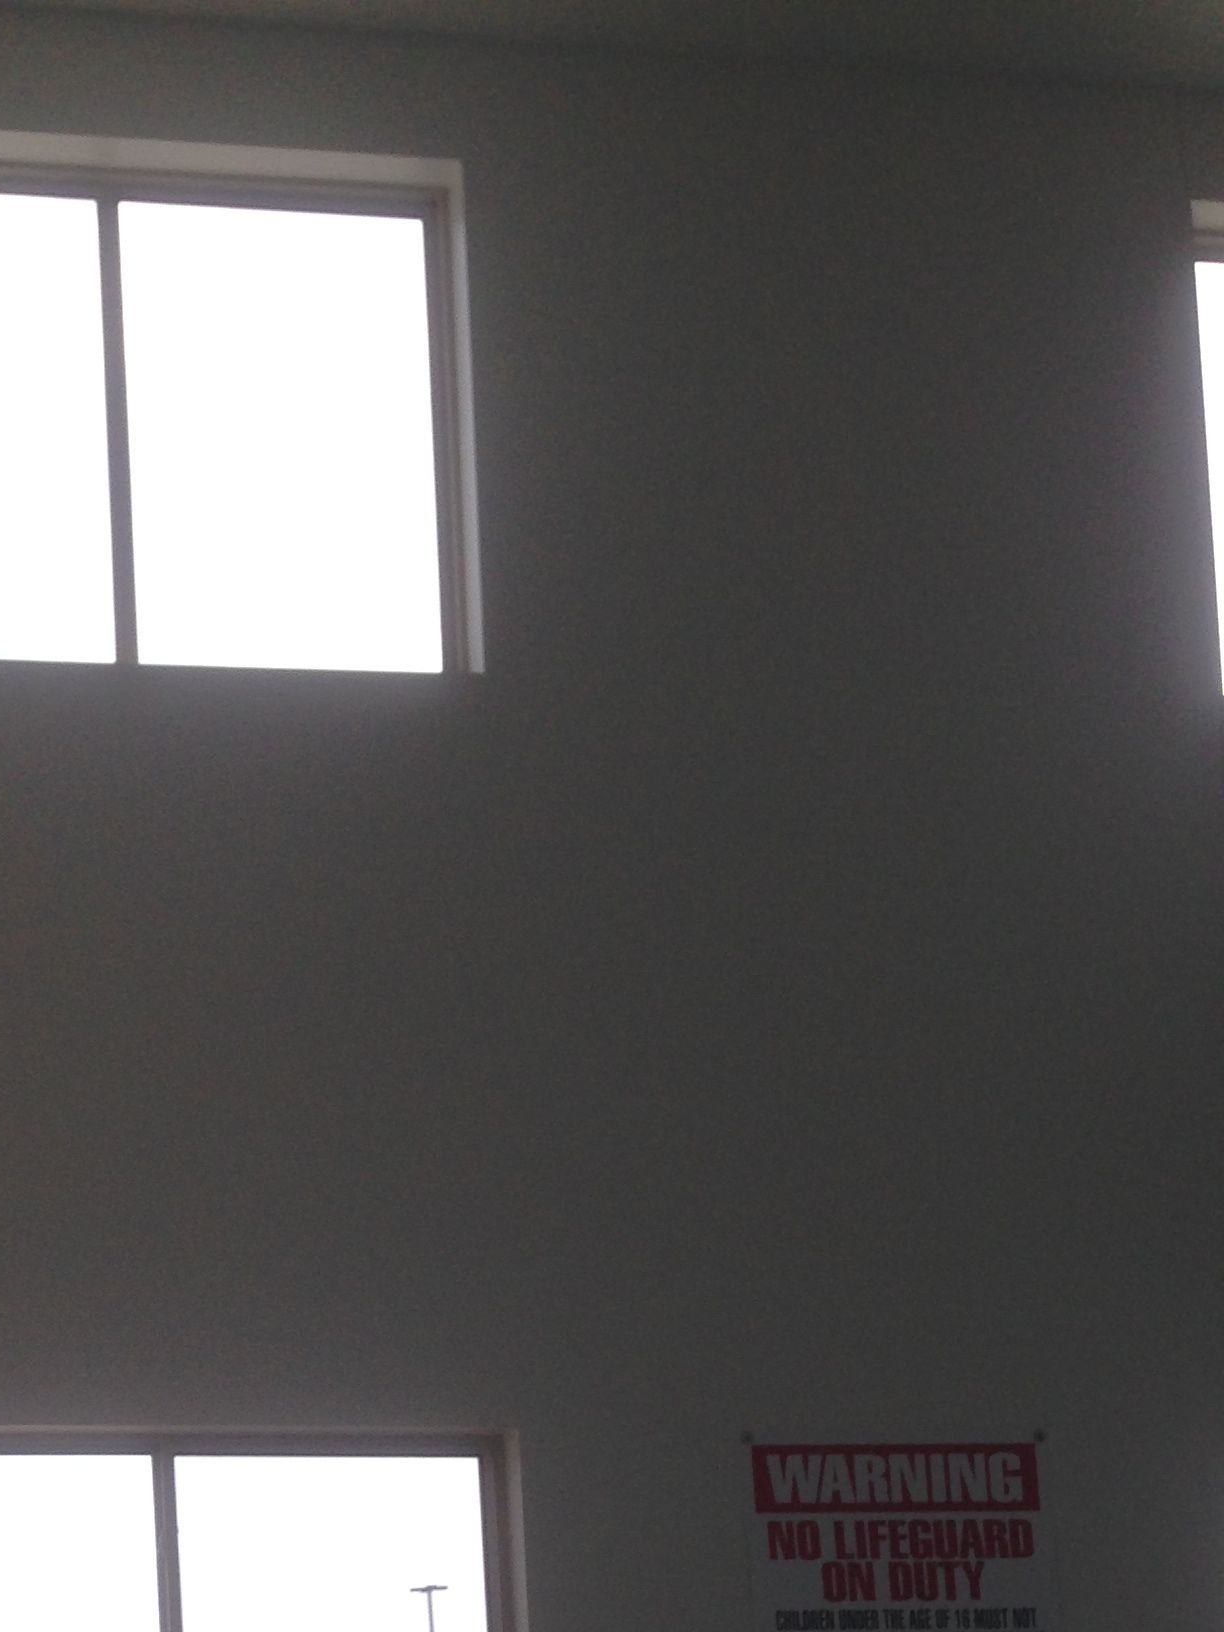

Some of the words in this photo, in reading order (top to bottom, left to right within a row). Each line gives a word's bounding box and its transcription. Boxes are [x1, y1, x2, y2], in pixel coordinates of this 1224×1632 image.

[766, 1452, 1024, 1504] WARNING
[767, 1520, 823, 1561] NO
[833, 1518, 1035, 1560] LIFEGUARD
[822, 1562, 877, 1602] ON
[888, 1560, 986, 1601] DUTY
[776, 1609, 835, 1631] CHILDREN
[839, 1609, 880, 1630] UNDER
[883, 1609, 906, 1630] THE
[909, 1608, 931, 1630] AGE
[935, 1608, 950, 1629] OF
[973, 1608, 1008, 1629] MUST
[1013, 1607, 1037, 1628] NOT
